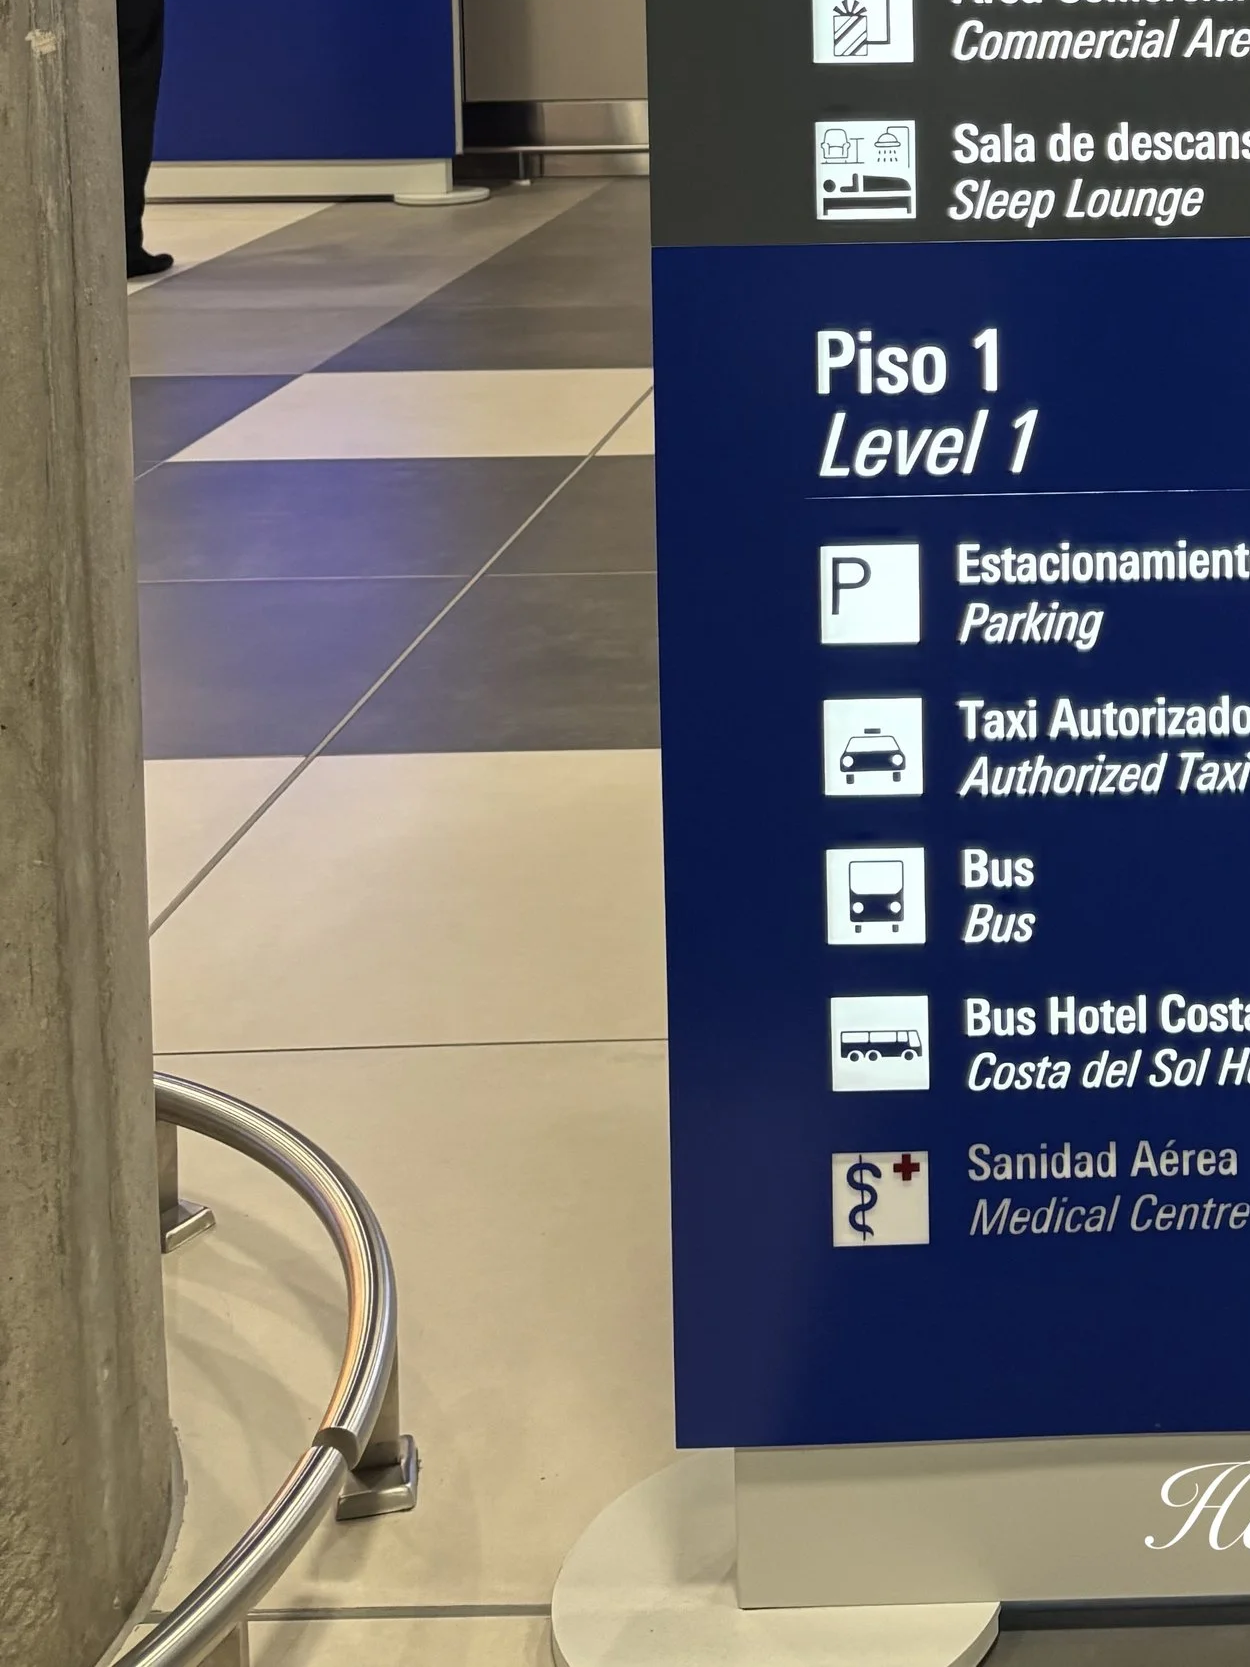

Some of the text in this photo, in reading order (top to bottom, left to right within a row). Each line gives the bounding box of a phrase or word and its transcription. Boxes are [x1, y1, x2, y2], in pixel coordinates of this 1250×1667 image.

[953, 19, 1180, 60] Commercial
[953, 123, 1035, 163] Sala
[1049, 123, 1094, 162] de
[949, 179, 1204, 228] Sleep Lounge
[818, 329, 997, 394] Piso 1
[820, 410, 1038, 476] Level 1
[959, 602, 1104, 650] Parking
[957, 700, 1036, 739] Taxi
[959, 753, 1167, 796] Authorized
[964, 849, 1034, 887] Bus
[963, 904, 1035, 943] Bus
[967, 998, 1036, 1036] Bus
[1050, 995, 1146, 1034] Hotel
[968, 1052, 1071, 1091] Costa
[1083, 1050, 1142, 1088] del
[1149, 1048, 1210, 1087] Sol
[969, 1140, 1237, 1180] Sanidad Aérea
[970, 1194, 1250, 1235] Medical Centre
